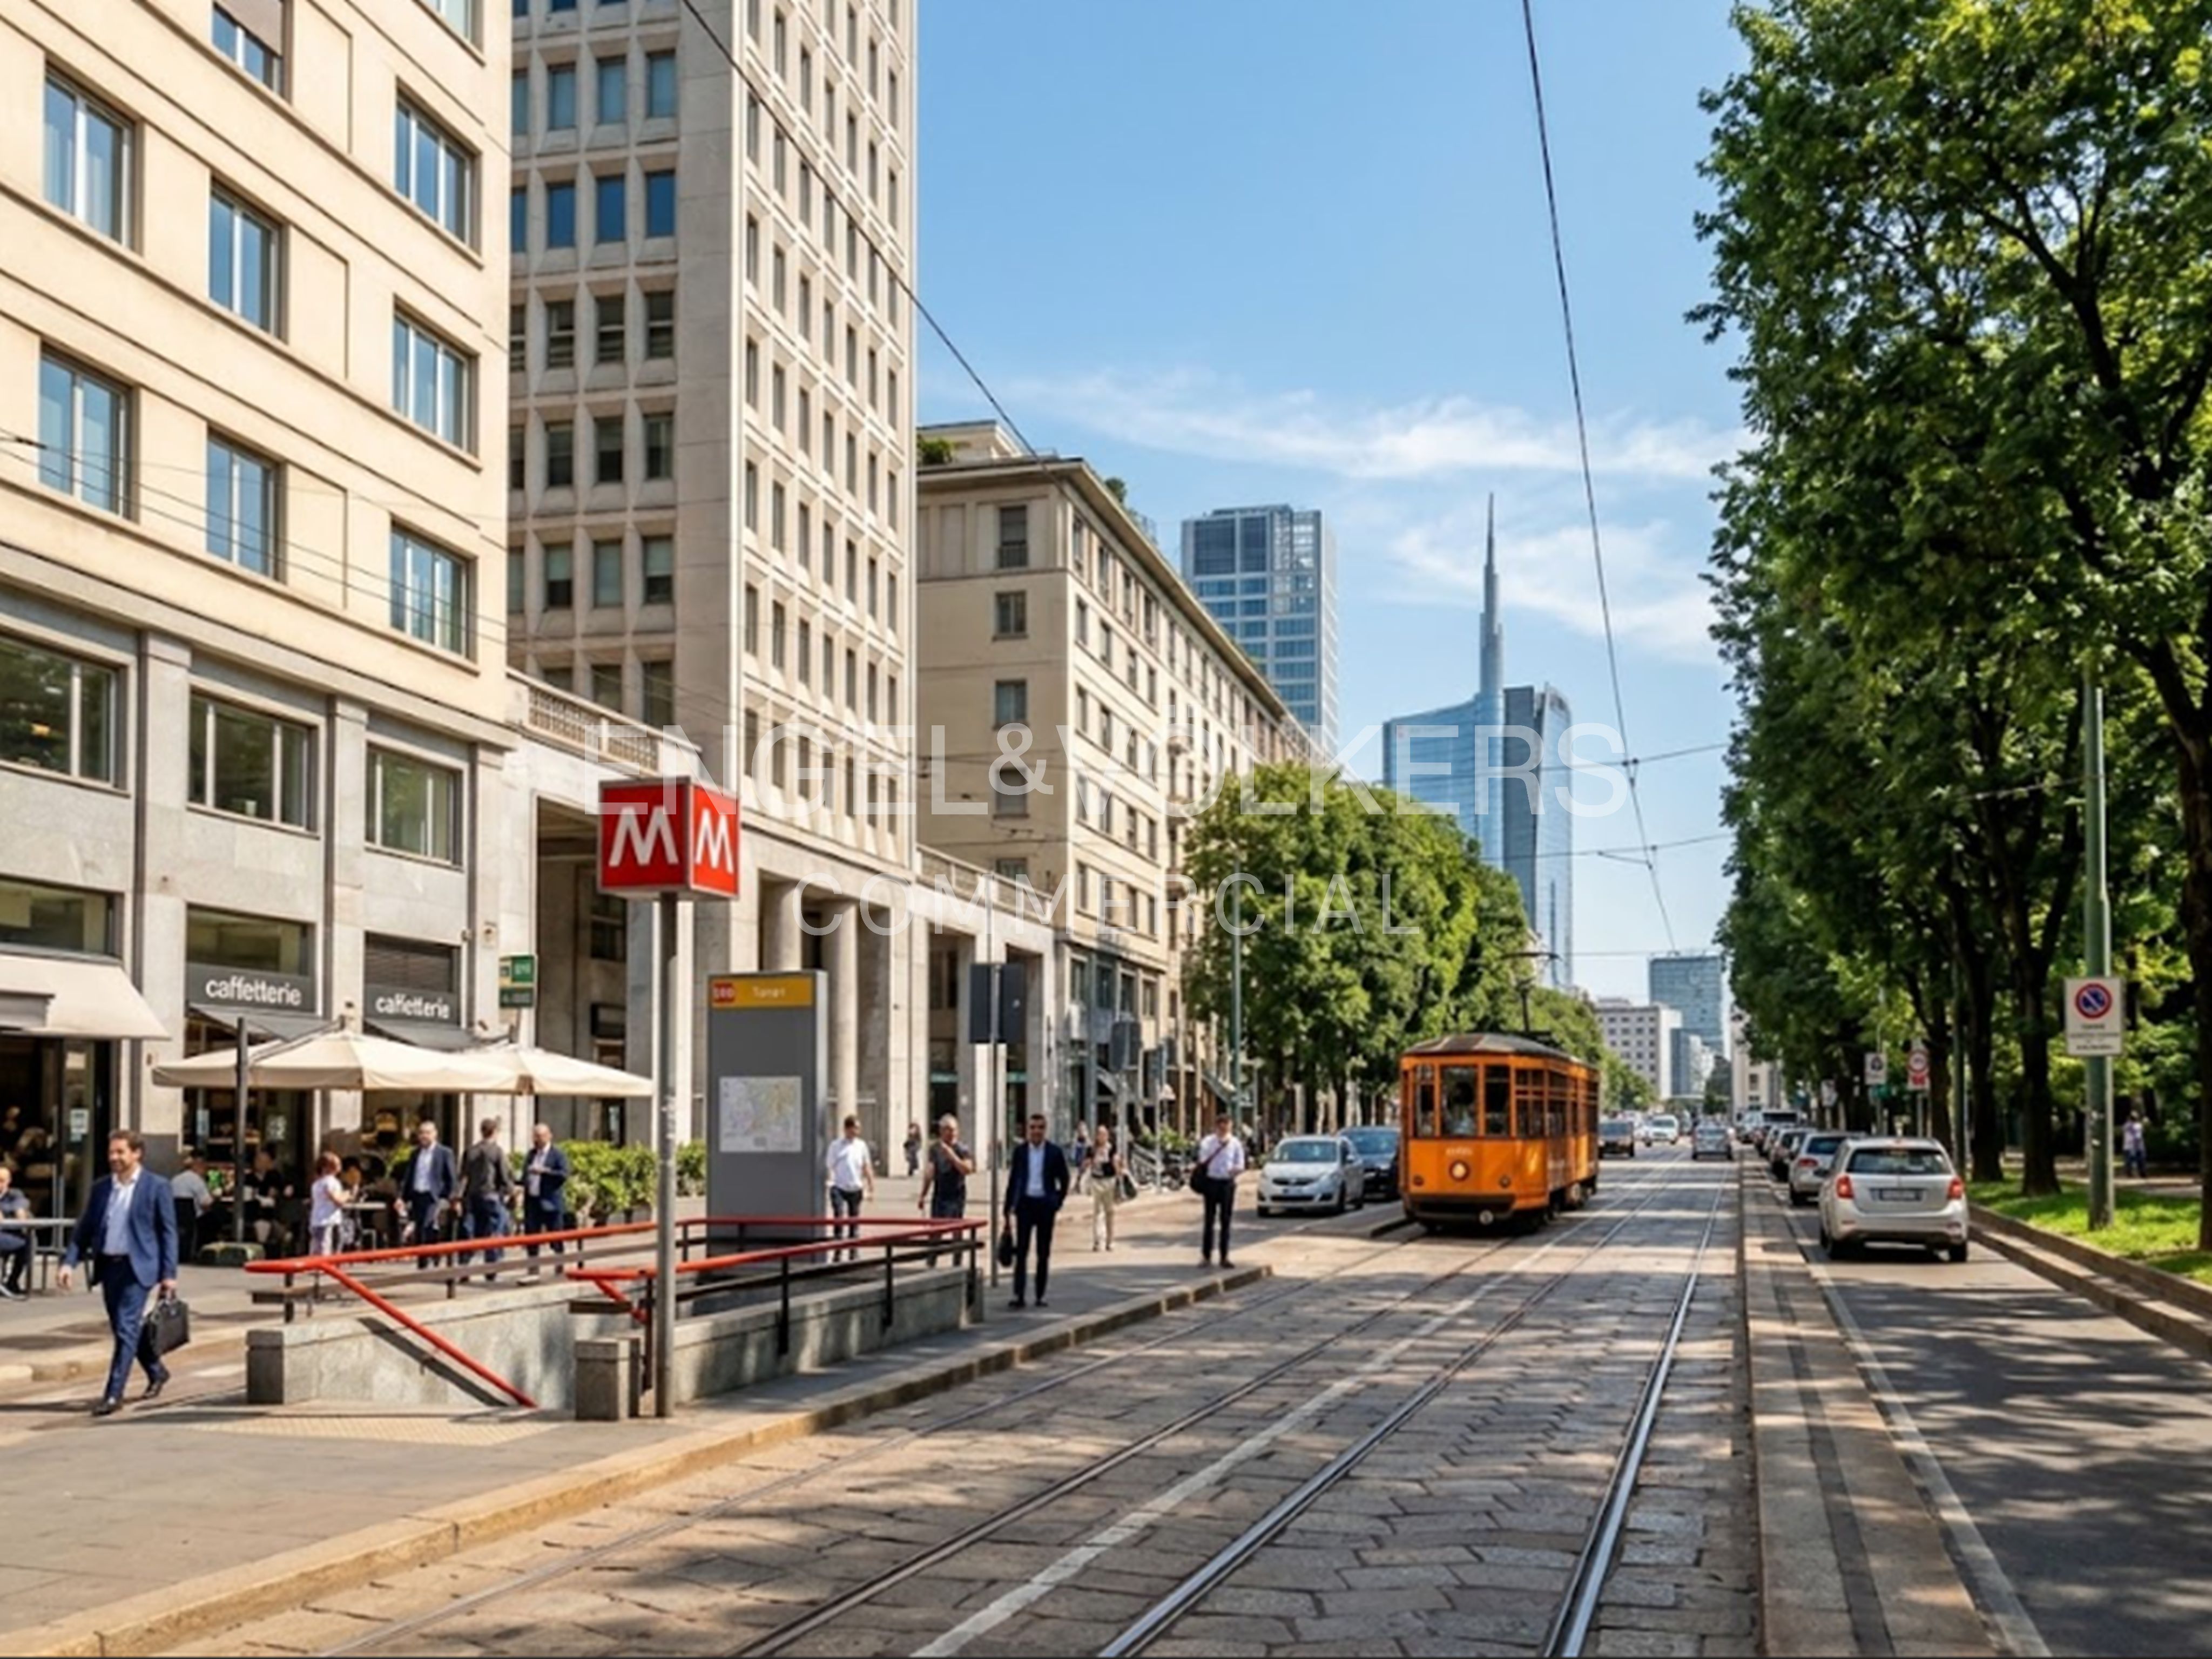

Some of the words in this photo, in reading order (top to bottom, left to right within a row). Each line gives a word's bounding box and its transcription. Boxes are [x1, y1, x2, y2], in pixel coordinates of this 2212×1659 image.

[608, 806, 679, 867] M
[696, 808, 734, 874] M
[205, 975, 302, 1006] caffetterie
